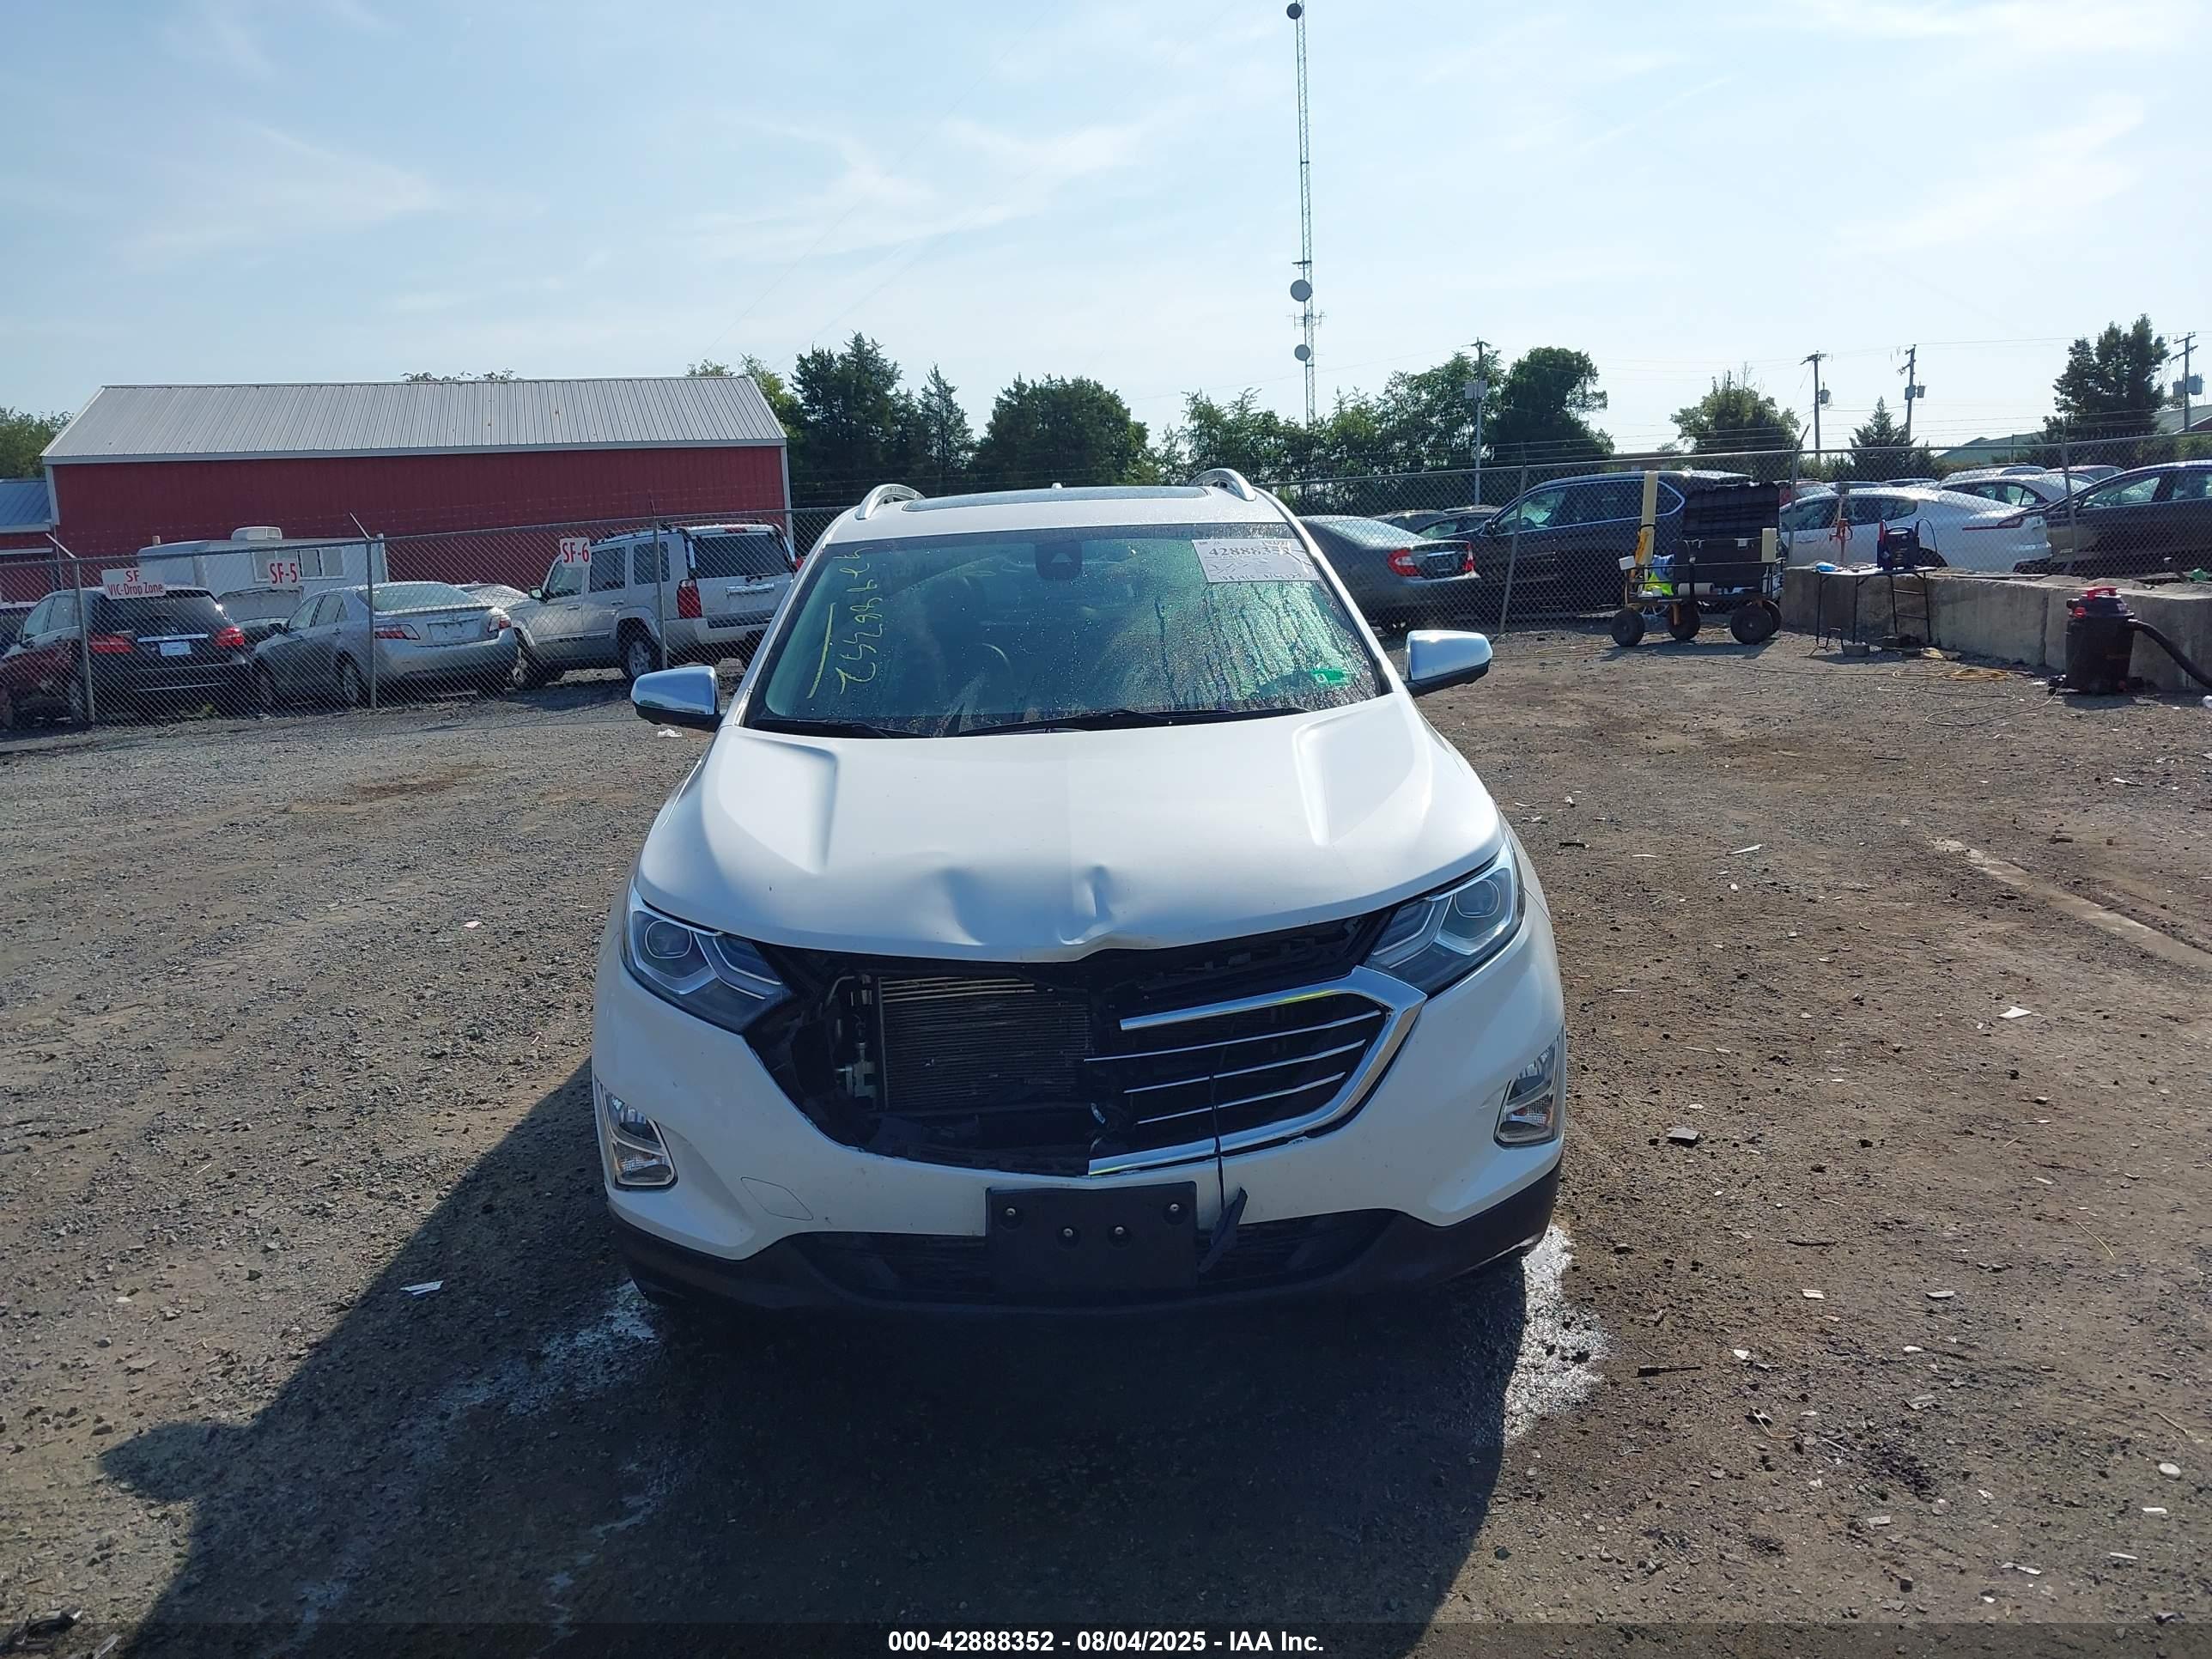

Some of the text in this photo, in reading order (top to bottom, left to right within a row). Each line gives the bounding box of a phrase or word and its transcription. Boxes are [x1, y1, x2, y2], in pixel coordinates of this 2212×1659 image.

[562, 542, 590, 563] SF-6
[125, 569, 140, 583] SF
[270, 562, 298, 584] SF-5
[106, 582, 164, 597] VIC-Drop Zone
